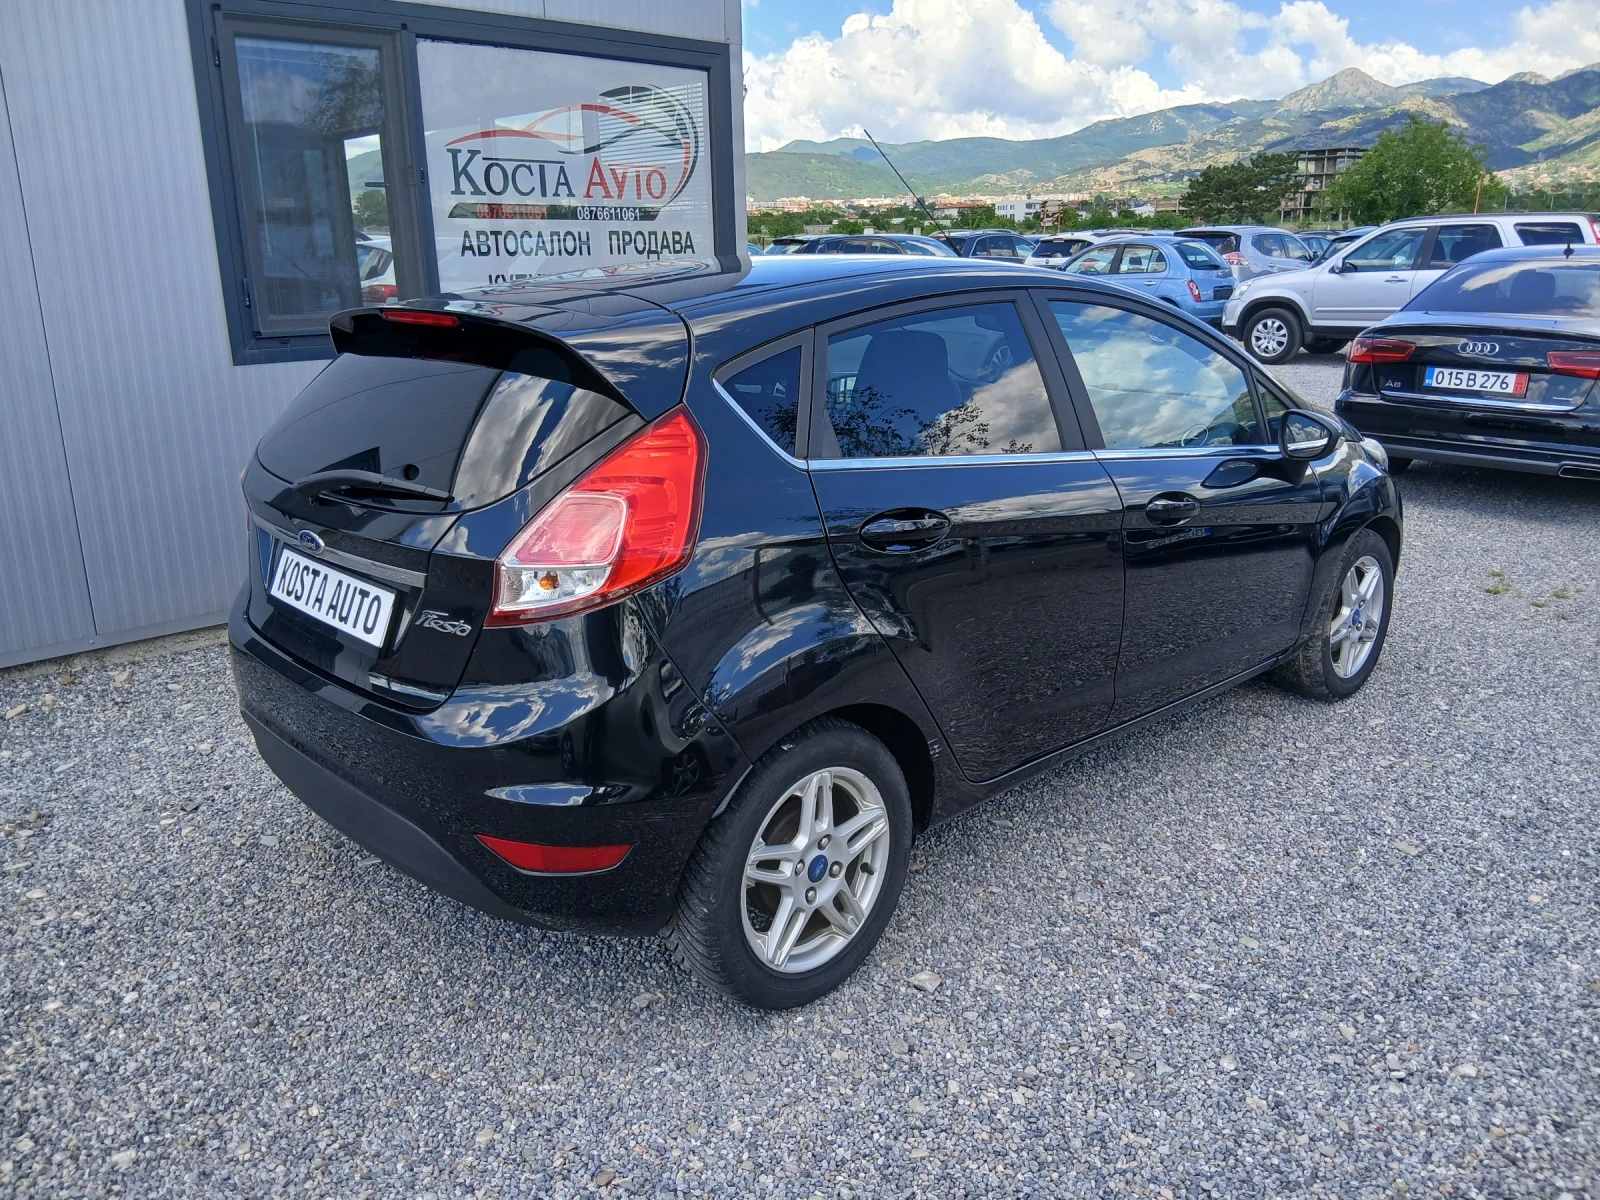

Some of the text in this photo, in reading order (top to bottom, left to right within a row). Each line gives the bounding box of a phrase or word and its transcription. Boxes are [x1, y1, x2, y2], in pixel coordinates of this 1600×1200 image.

[476, 204, 640, 220] 0876611061 0876611061
[460, 230, 696, 260] АВТОСАЛОН ПРОДАВА
[1385, 379, 1402, 388] A6
[277, 556, 382, 635] KOSTA AUTO
[415, 609, 472, 637] Fiesta
